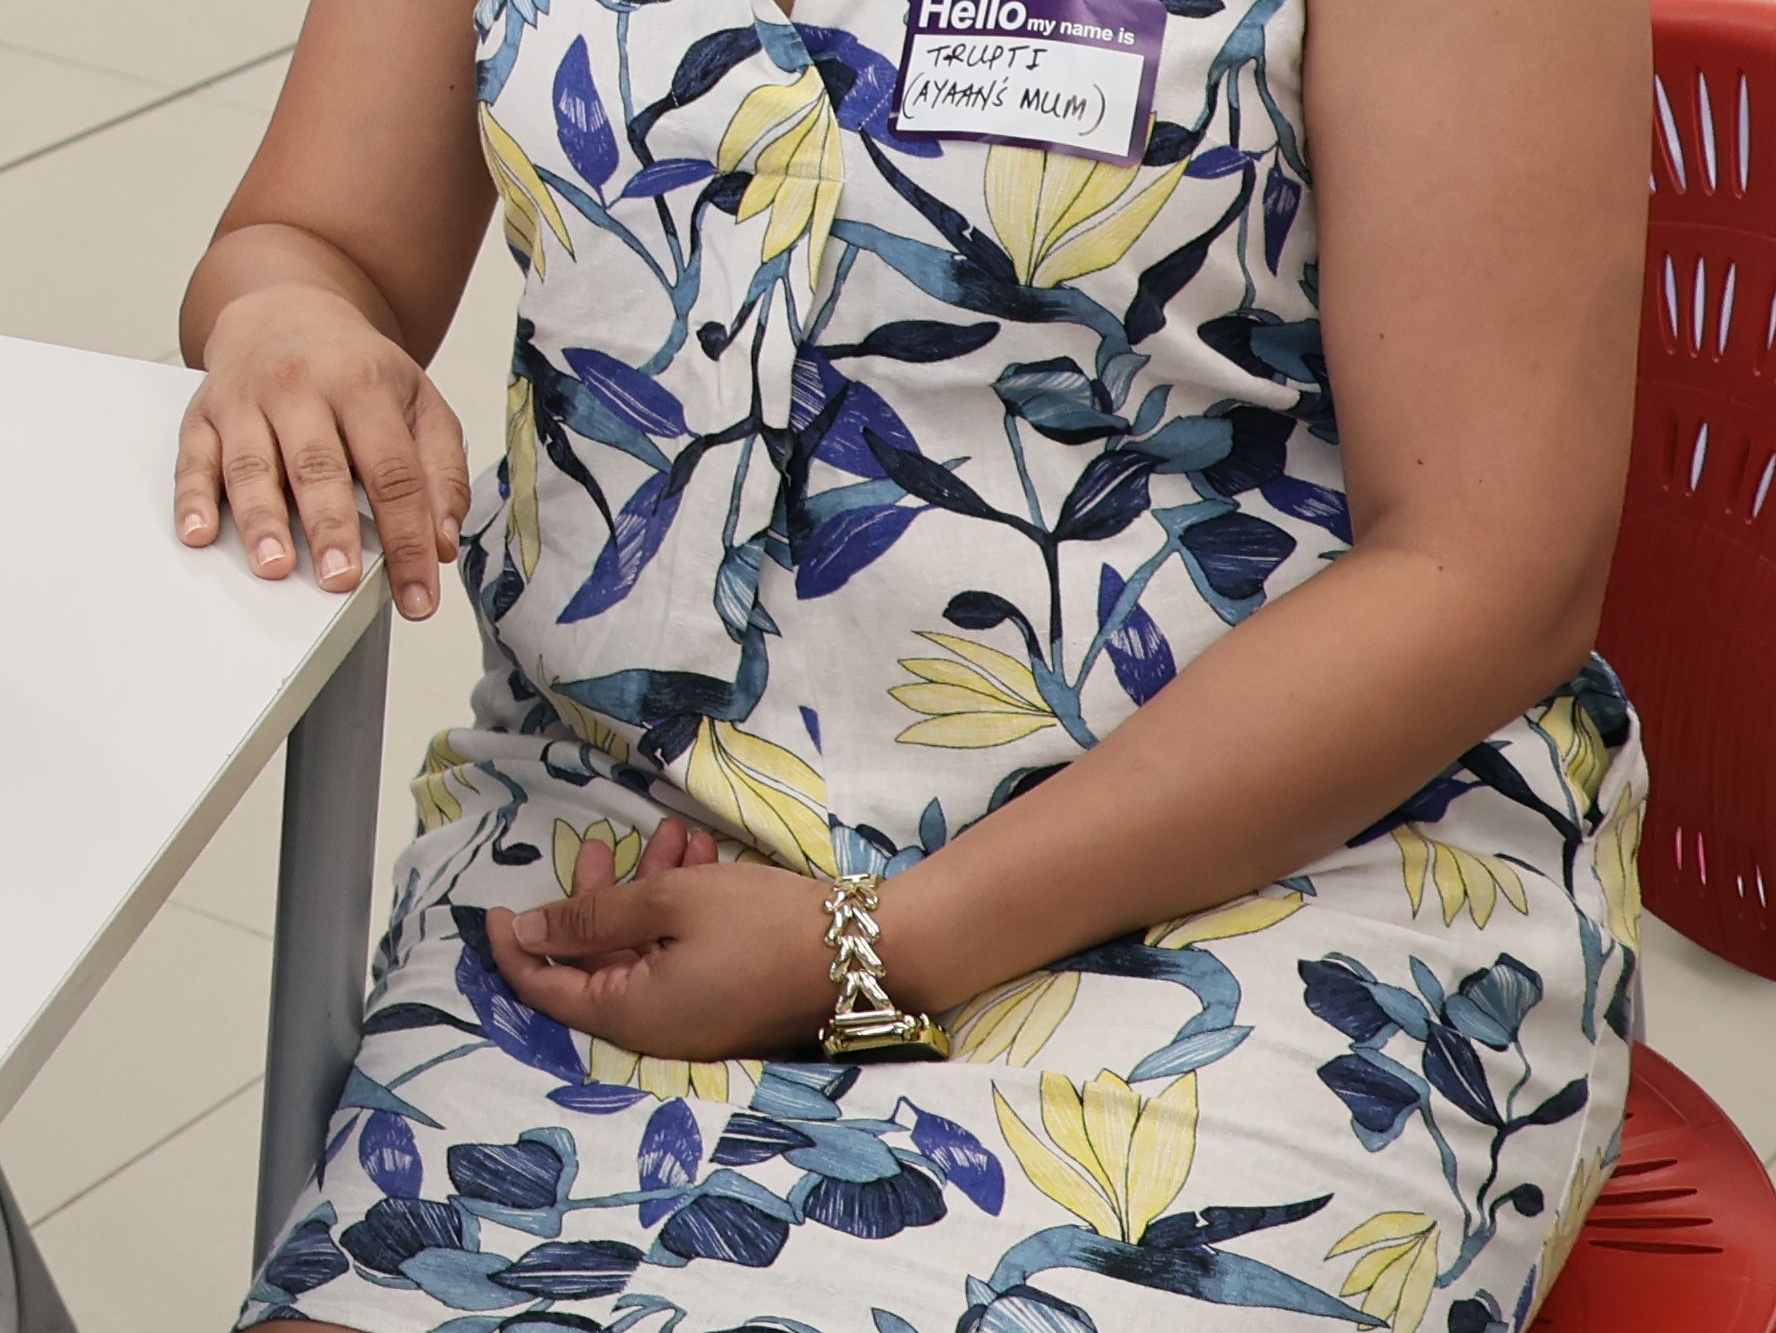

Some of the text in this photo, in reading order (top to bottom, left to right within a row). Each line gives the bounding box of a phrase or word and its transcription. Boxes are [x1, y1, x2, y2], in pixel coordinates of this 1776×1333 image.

[1027, 17, 1056, 36] my
[1059, 20, 1114, 44] name
[1117, 26, 1136, 46] is
[926, 42, 1049, 72] TRUPTI
[1019, 83, 1106, 137] MUM)
